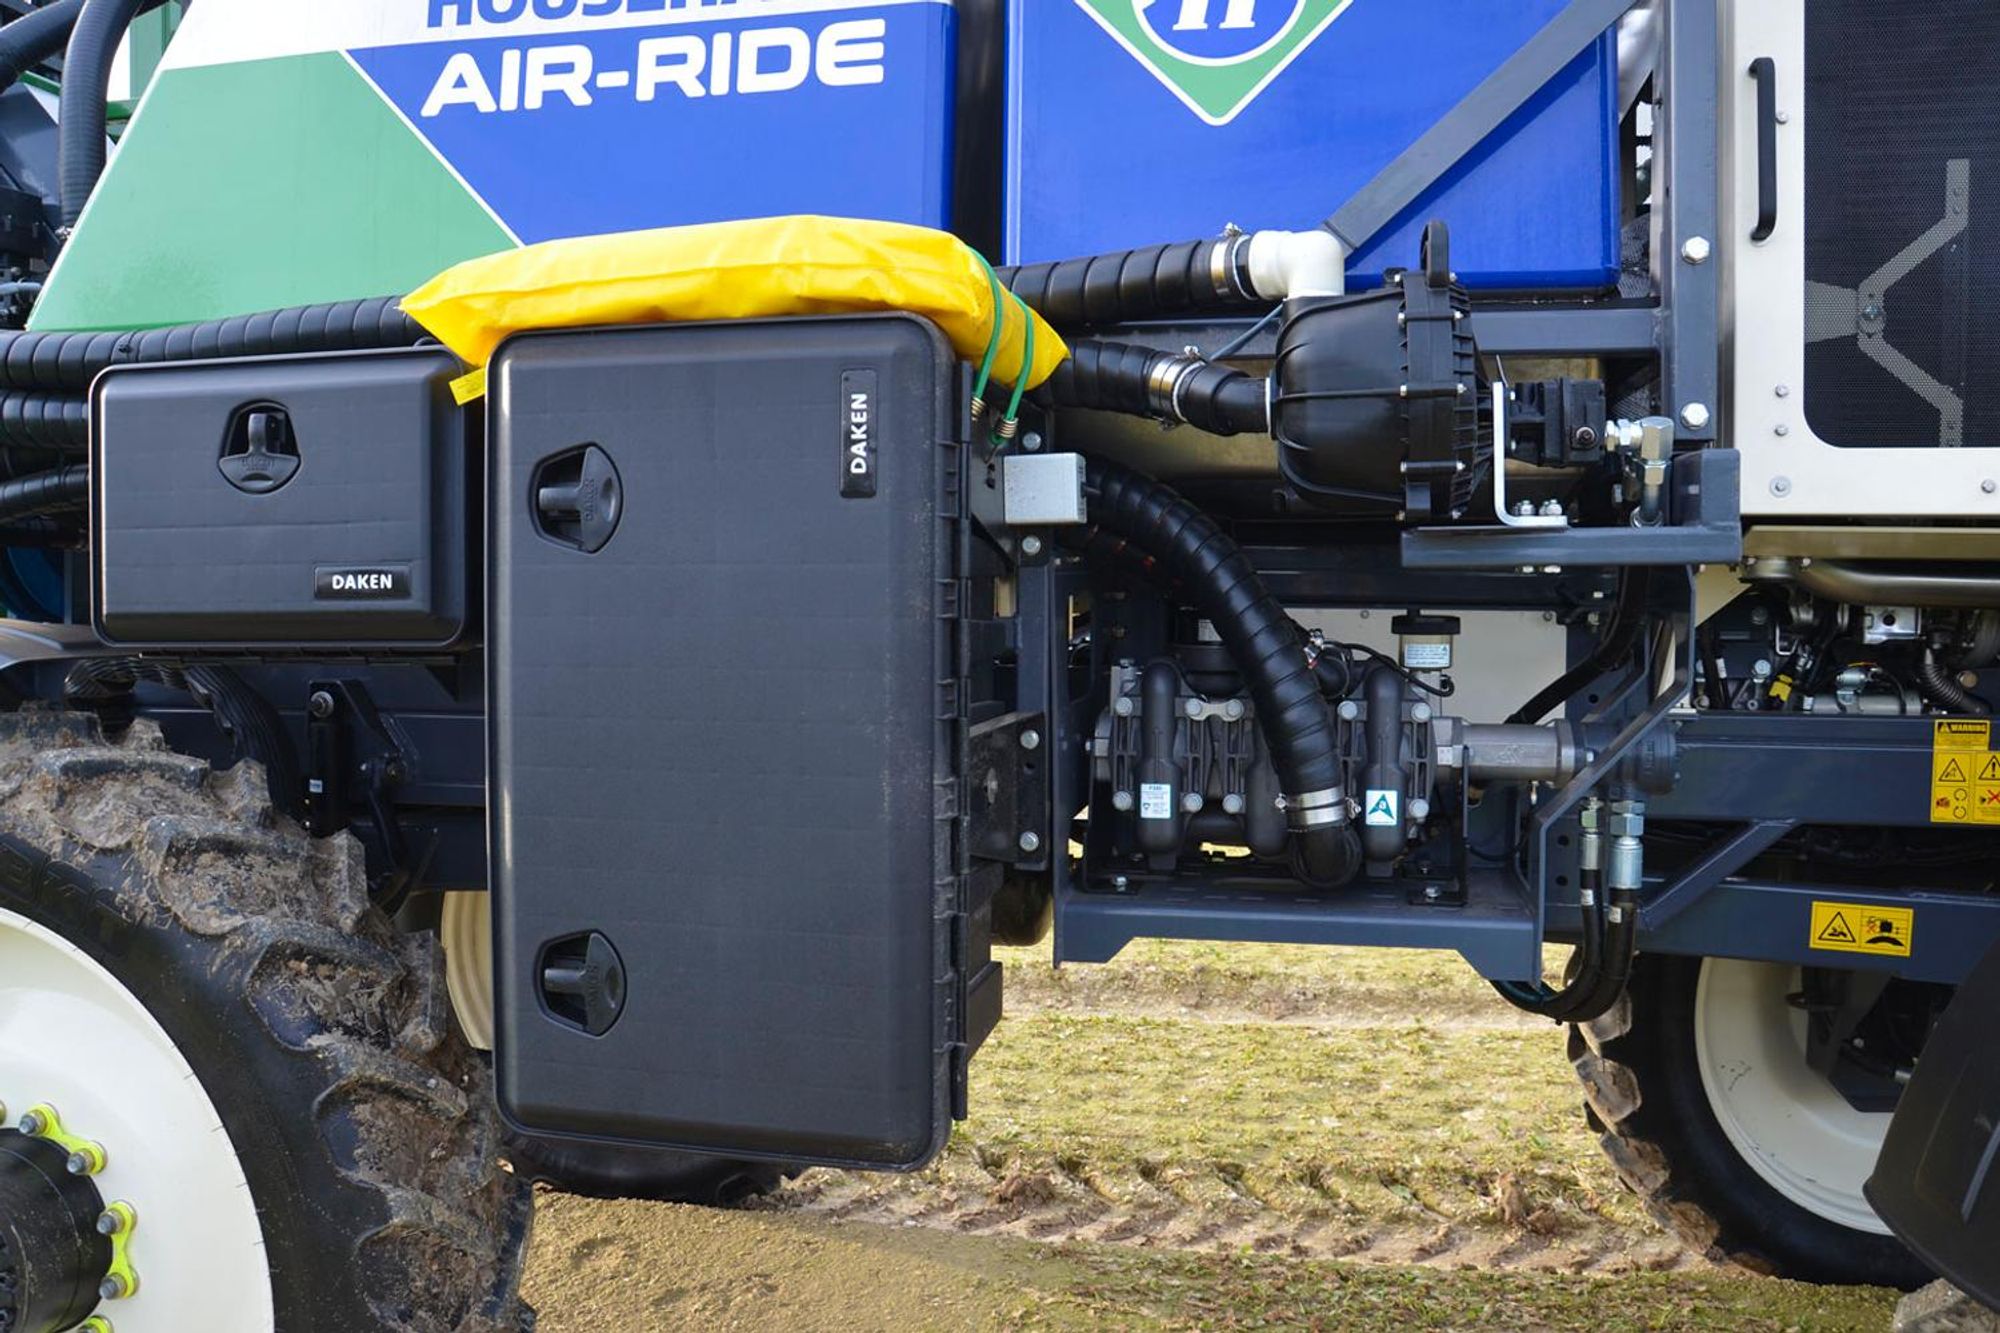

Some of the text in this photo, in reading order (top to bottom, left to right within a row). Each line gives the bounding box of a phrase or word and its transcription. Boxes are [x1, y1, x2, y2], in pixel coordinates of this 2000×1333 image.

[420, 18, 886, 117] AIR-RIDE
[850, 393, 867, 473] DAKEN
[332, 574, 392, 589] DAKEN
